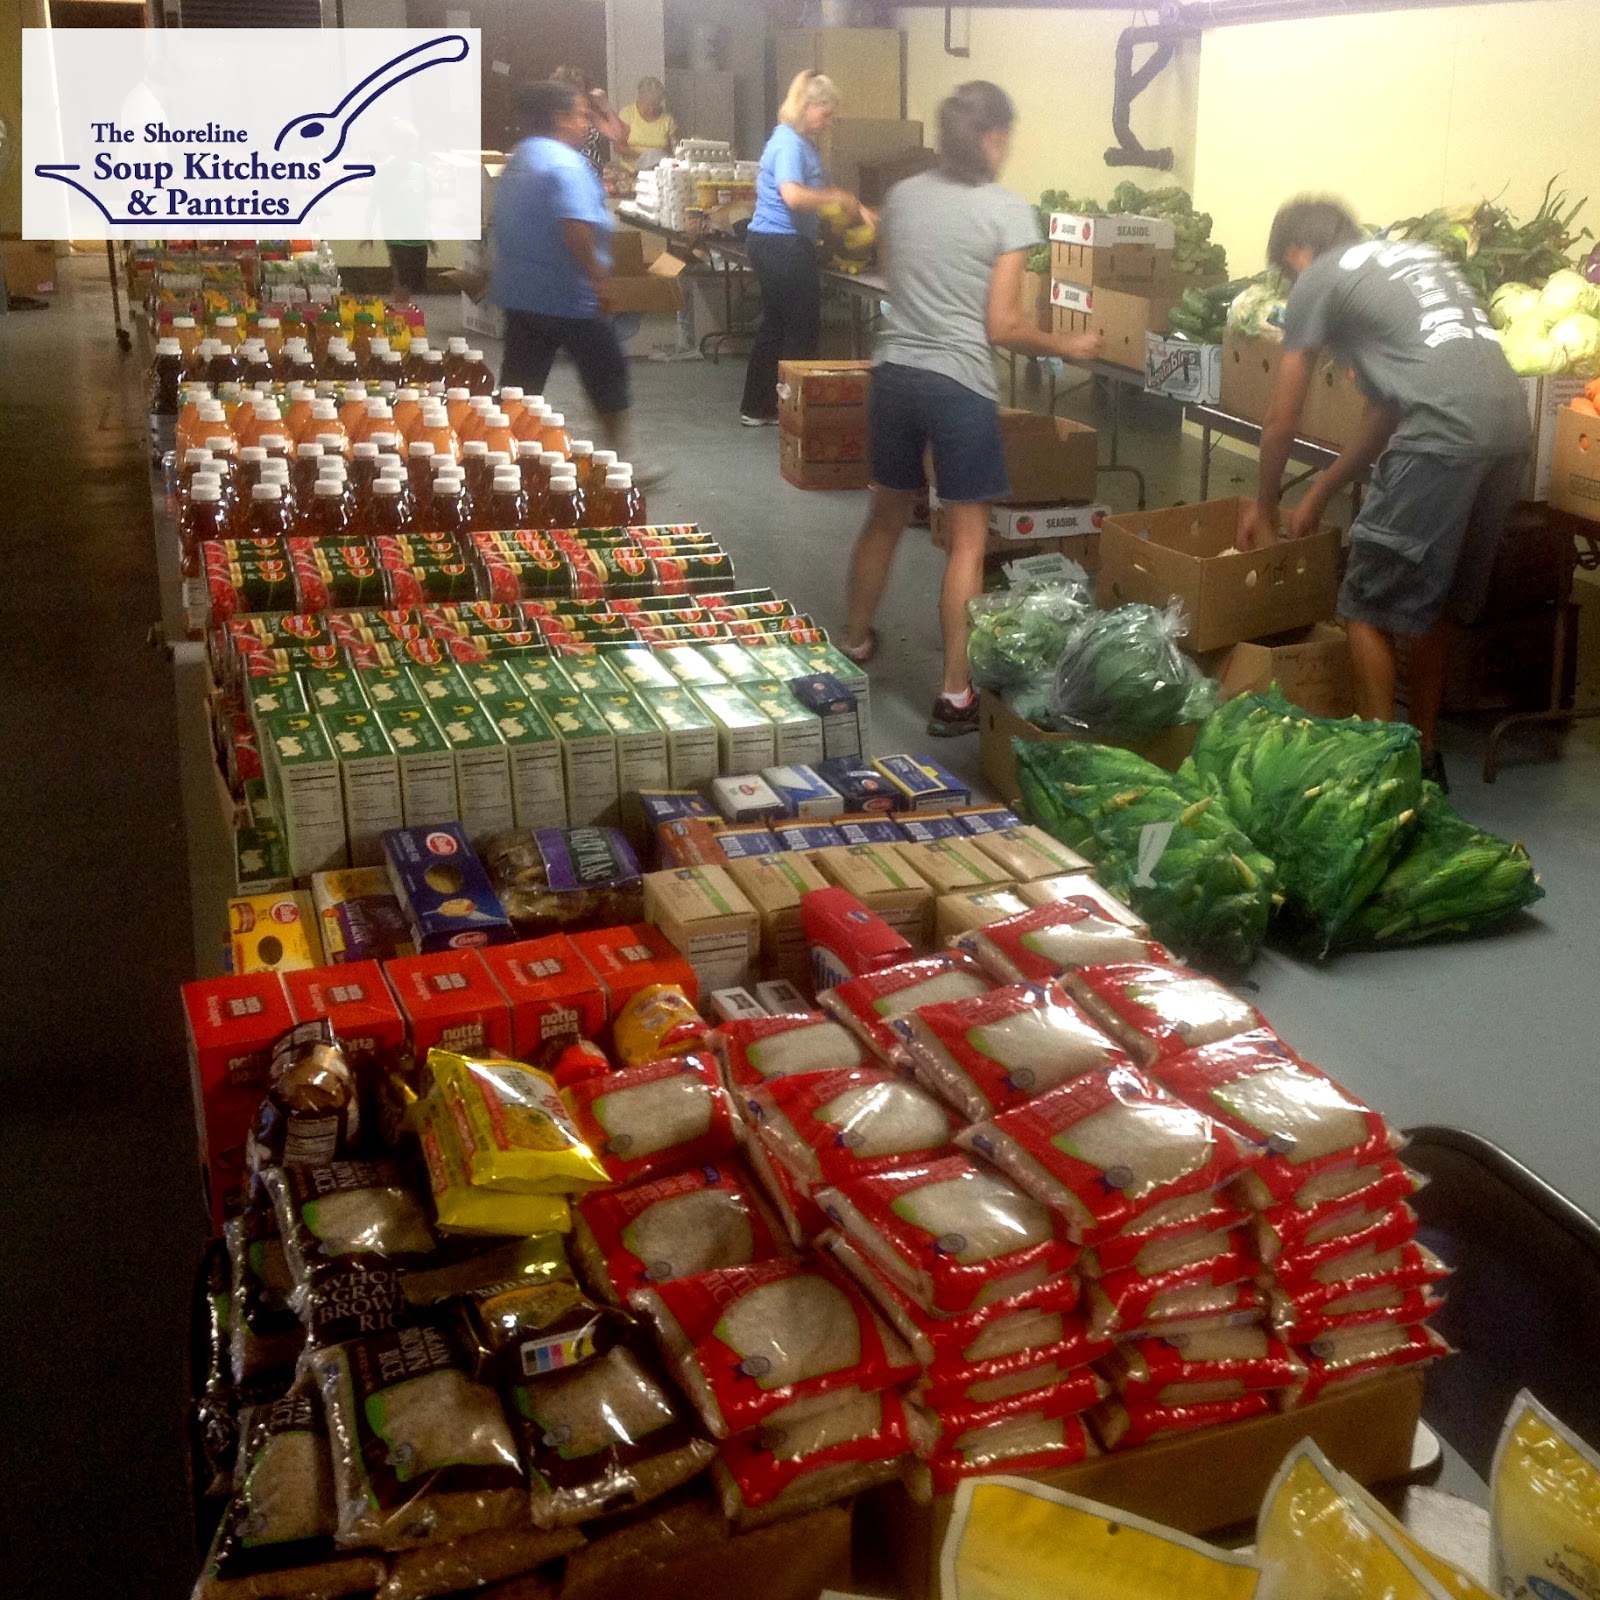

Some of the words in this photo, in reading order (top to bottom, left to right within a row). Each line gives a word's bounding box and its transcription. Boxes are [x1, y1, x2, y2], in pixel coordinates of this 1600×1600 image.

[1117, 225, 1150, 237] SEASIDE
[1046, 518, 1079, 529] SEASIDE
[322, 1270, 398, 1290] WHOL
[331, 1284, 397, 1301] GRAI
[360, 1312, 398, 1331] RIC
